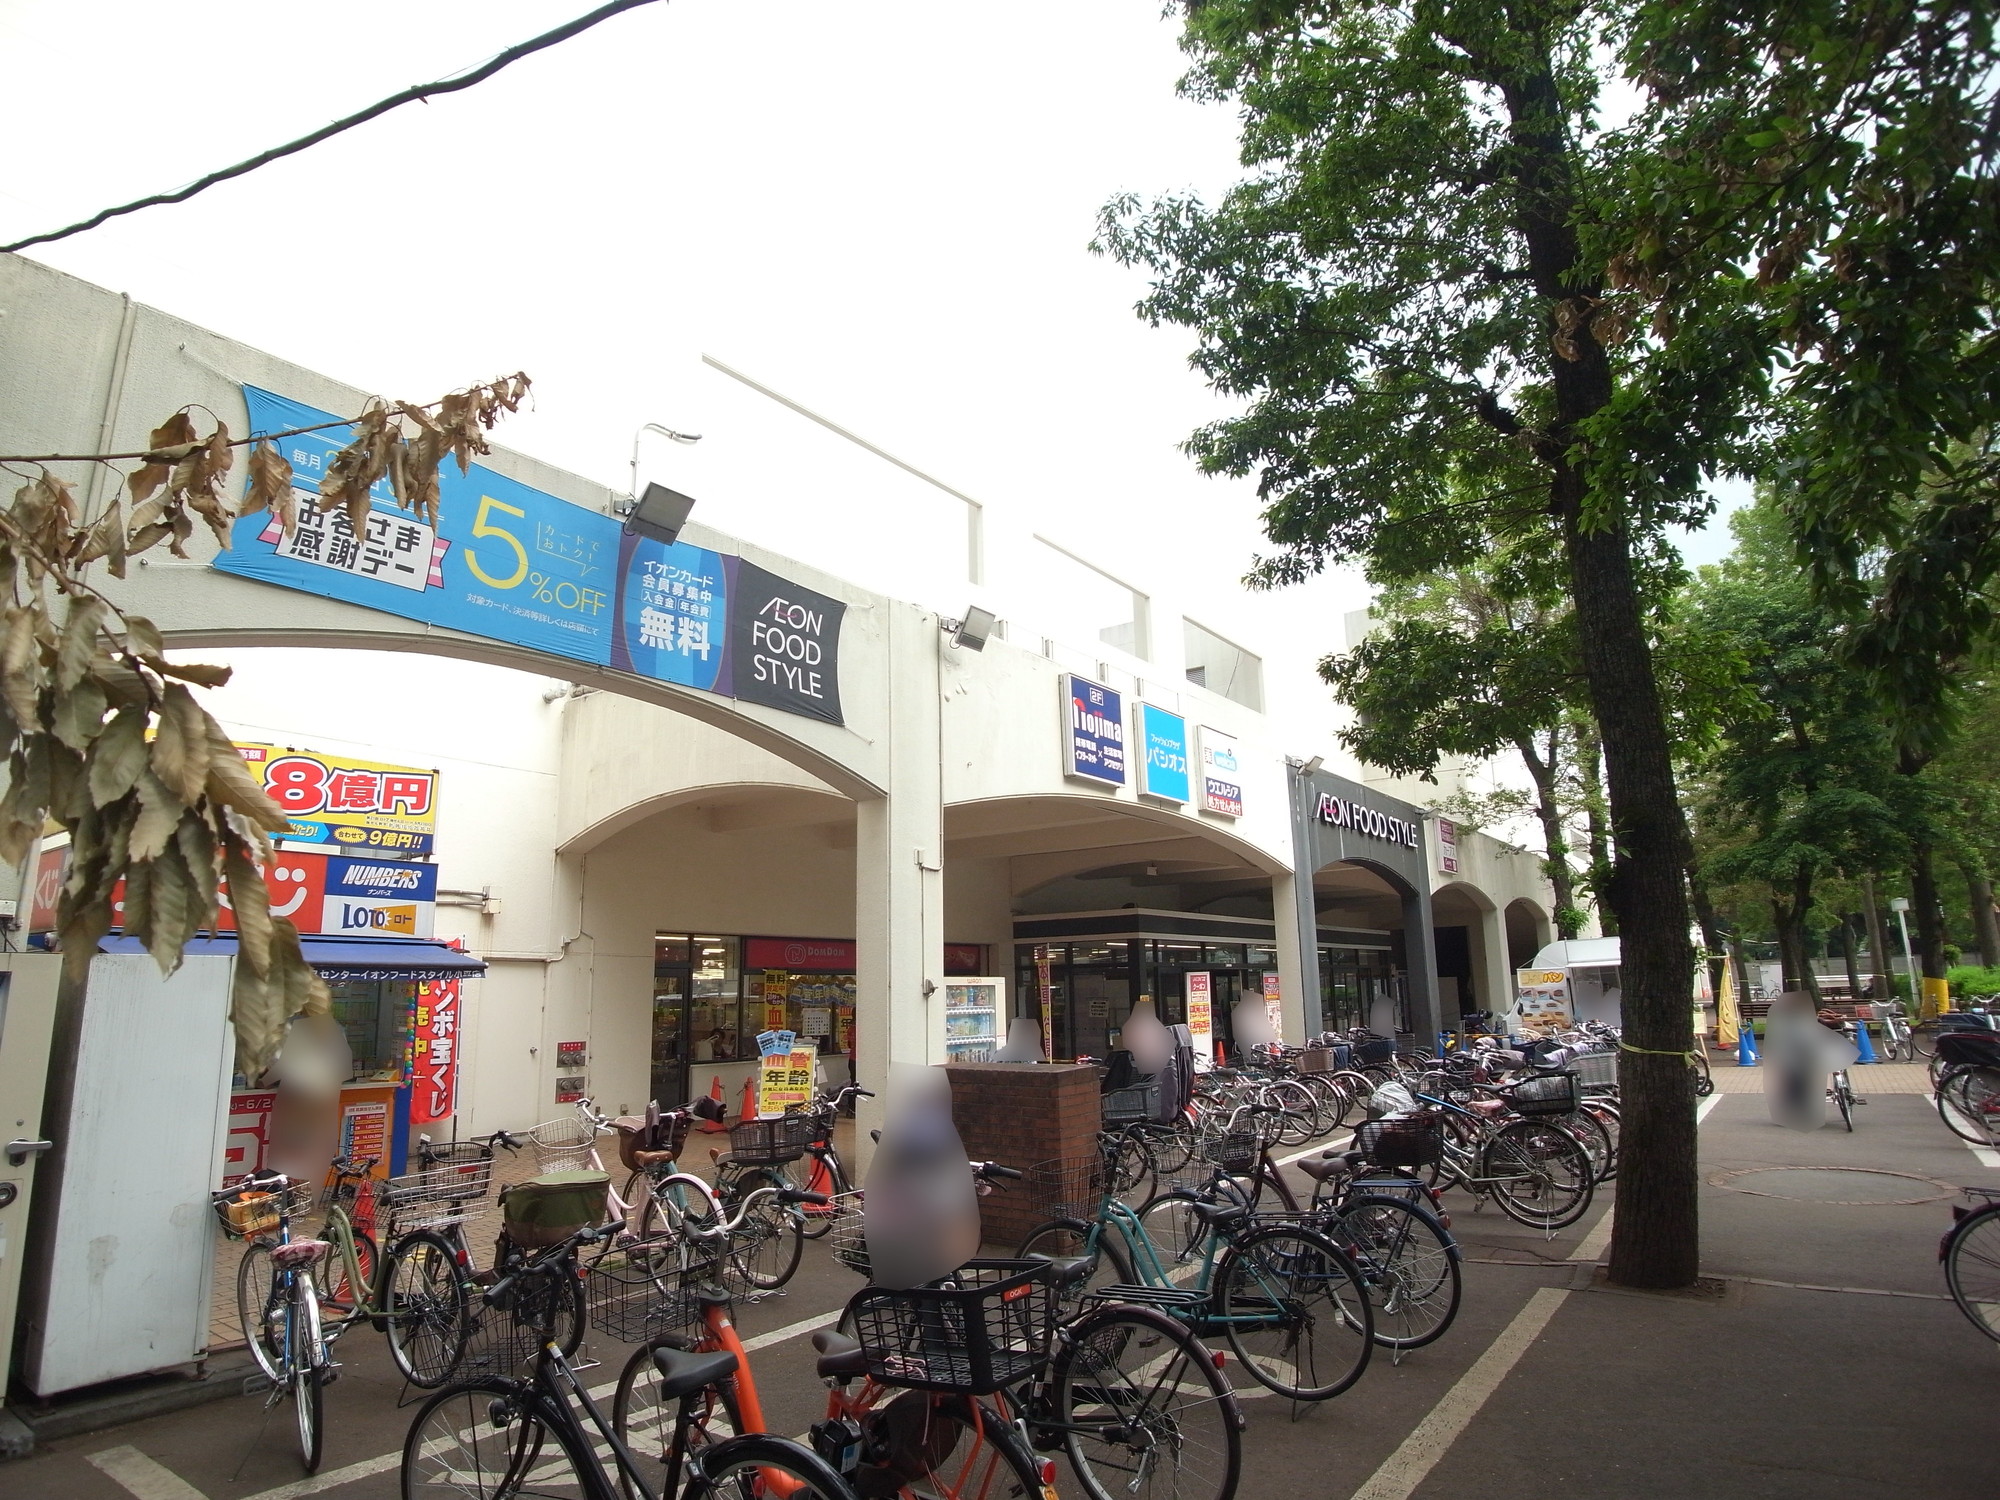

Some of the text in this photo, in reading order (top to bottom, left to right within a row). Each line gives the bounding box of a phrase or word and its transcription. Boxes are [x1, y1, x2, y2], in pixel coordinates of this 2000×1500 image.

[298, 498, 421, 553] お客さま
[545, 524, 600, 551] カードで
[290, 526, 415, 575] 感謝デー
[643, 560, 713, 586] イオンカード
[642, 573, 712, 604] 会員募集中
[643, 591, 709, 618] 入会金 年会費
[639, 606, 710, 661] 無料
[753, 620, 821, 665] FOOD
[753, 654, 823, 699] STYLE
[1148, 747, 1188, 775] パシオス
[265, 756, 434, 815] 8億円
[338, 830, 364, 840] 合わせて
[1353, 803, 1387, 838] FOOD
[1388, 816, 1419, 848] STYLE
[342, 864, 422, 889] NUMBERS
[367, 889, 393, 897] ナンバーズ
[341, 903, 386, 929] LOTO
[765, 1069, 810, 1086] 年齢
